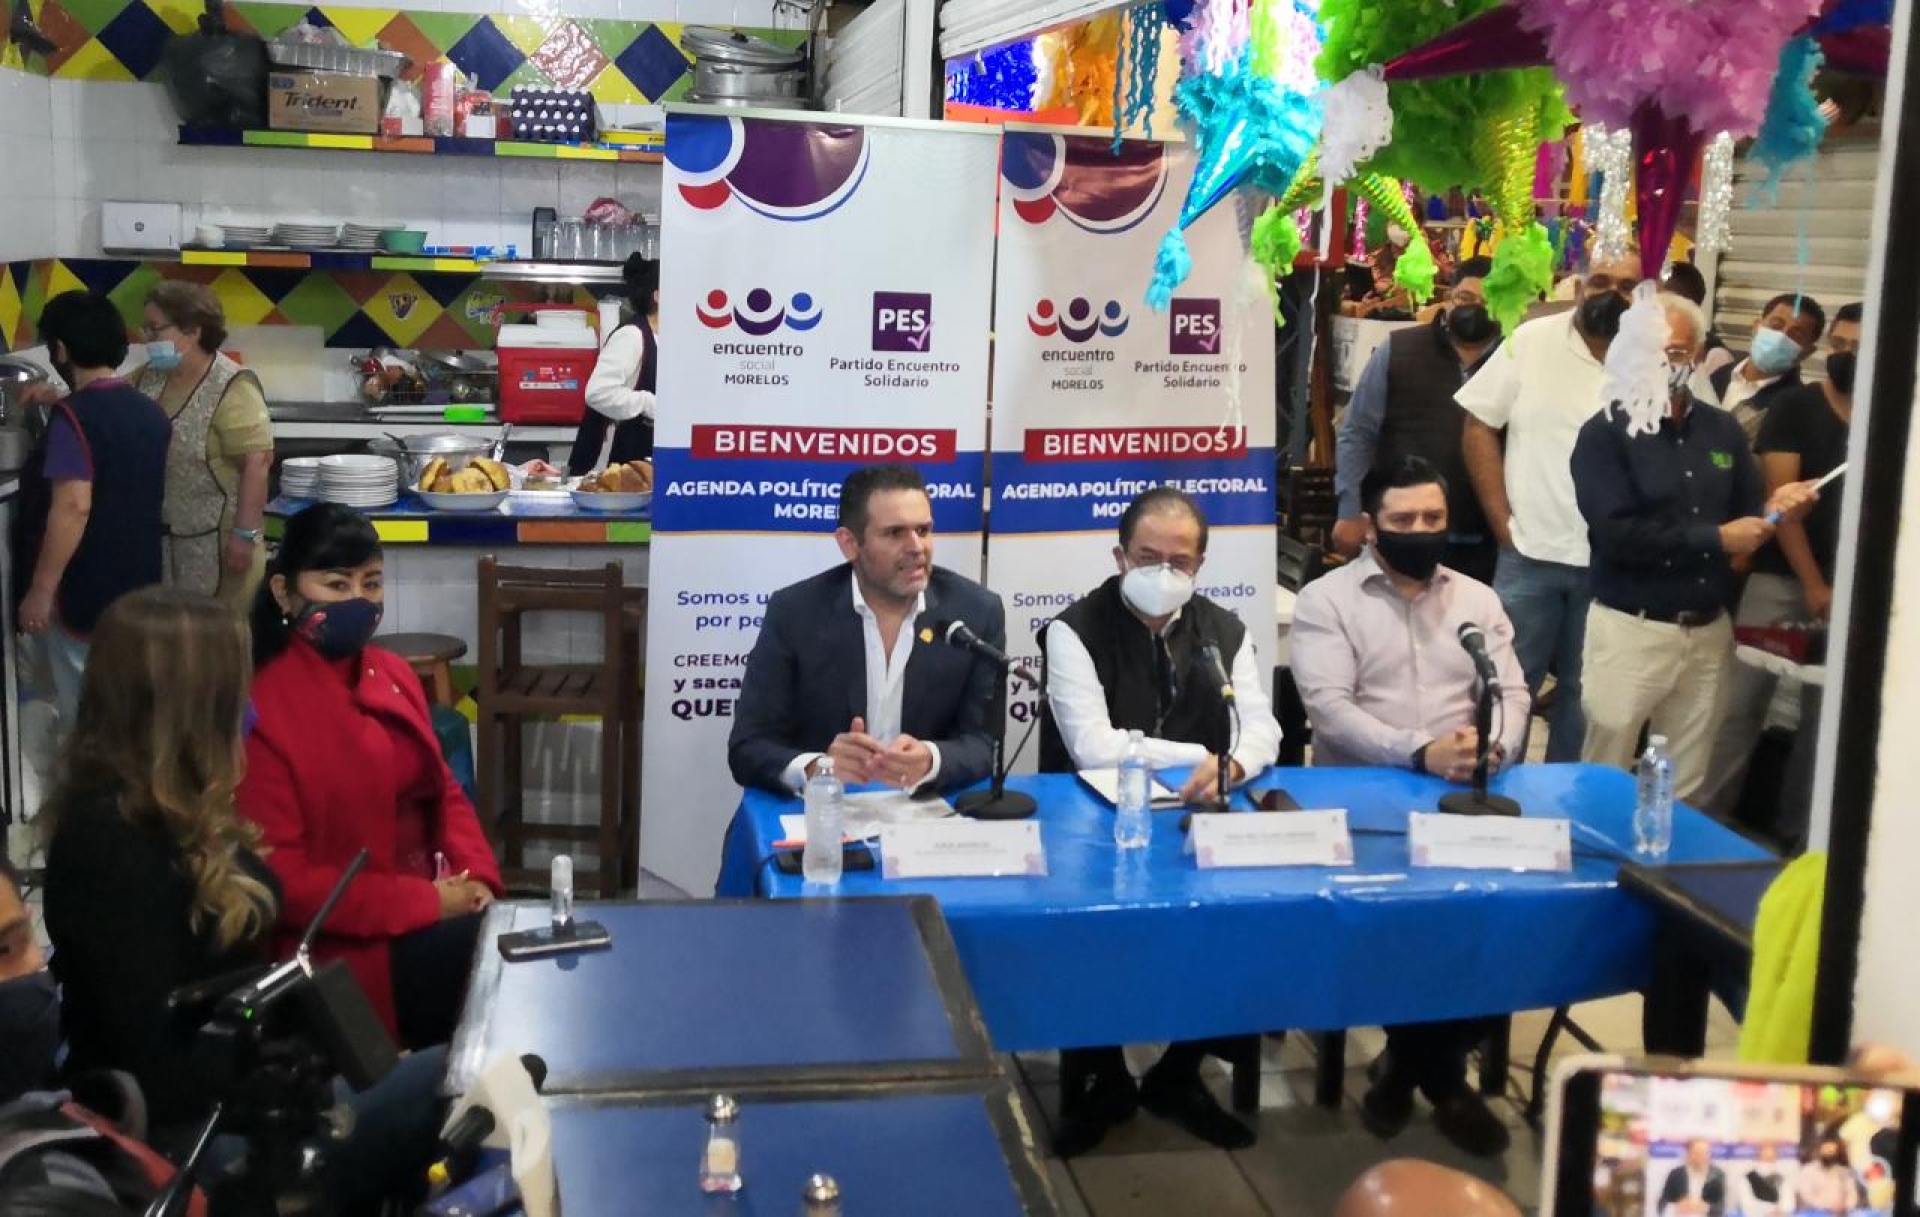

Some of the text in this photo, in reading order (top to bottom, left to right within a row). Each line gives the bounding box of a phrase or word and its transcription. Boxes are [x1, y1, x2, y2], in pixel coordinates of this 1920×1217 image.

[284, 91, 358, 110] Trident
[878, 308, 926, 332] PES
[1175, 314, 1216, 336] PES
[713, 342, 804, 357] encuentro
[1042, 348, 1115, 362] encuentro
[740, 360, 775, 371] social
[830, 357, 960, 372] Partido Encuentro
[1135, 361, 1247, 373] Partido Encueno
[725, 374, 789, 386] MORELOS
[864, 374, 929, 387] Solidario
[1051, 379, 1104, 390] MORELOS
[1163, 375, 1220, 388] Solidario
[714, 430, 937, 457] BIENVENIDOS
[1043, 431, 1228, 456] BIENVENIDOS
[665, 481, 754, 496] AGENDA
[759, 478, 842, 499] POLÍTIC
[1001, 483, 1078, 499] AGENDA
[1081, 478, 1158, 497] POLÍTICA
[677, 590, 749, 606] Somos
[1013, 592, 1075, 607] Somos
[695, 614, 731, 631] por
[673, 678, 686, 694] y
[1010, 680, 1021, 695] y
